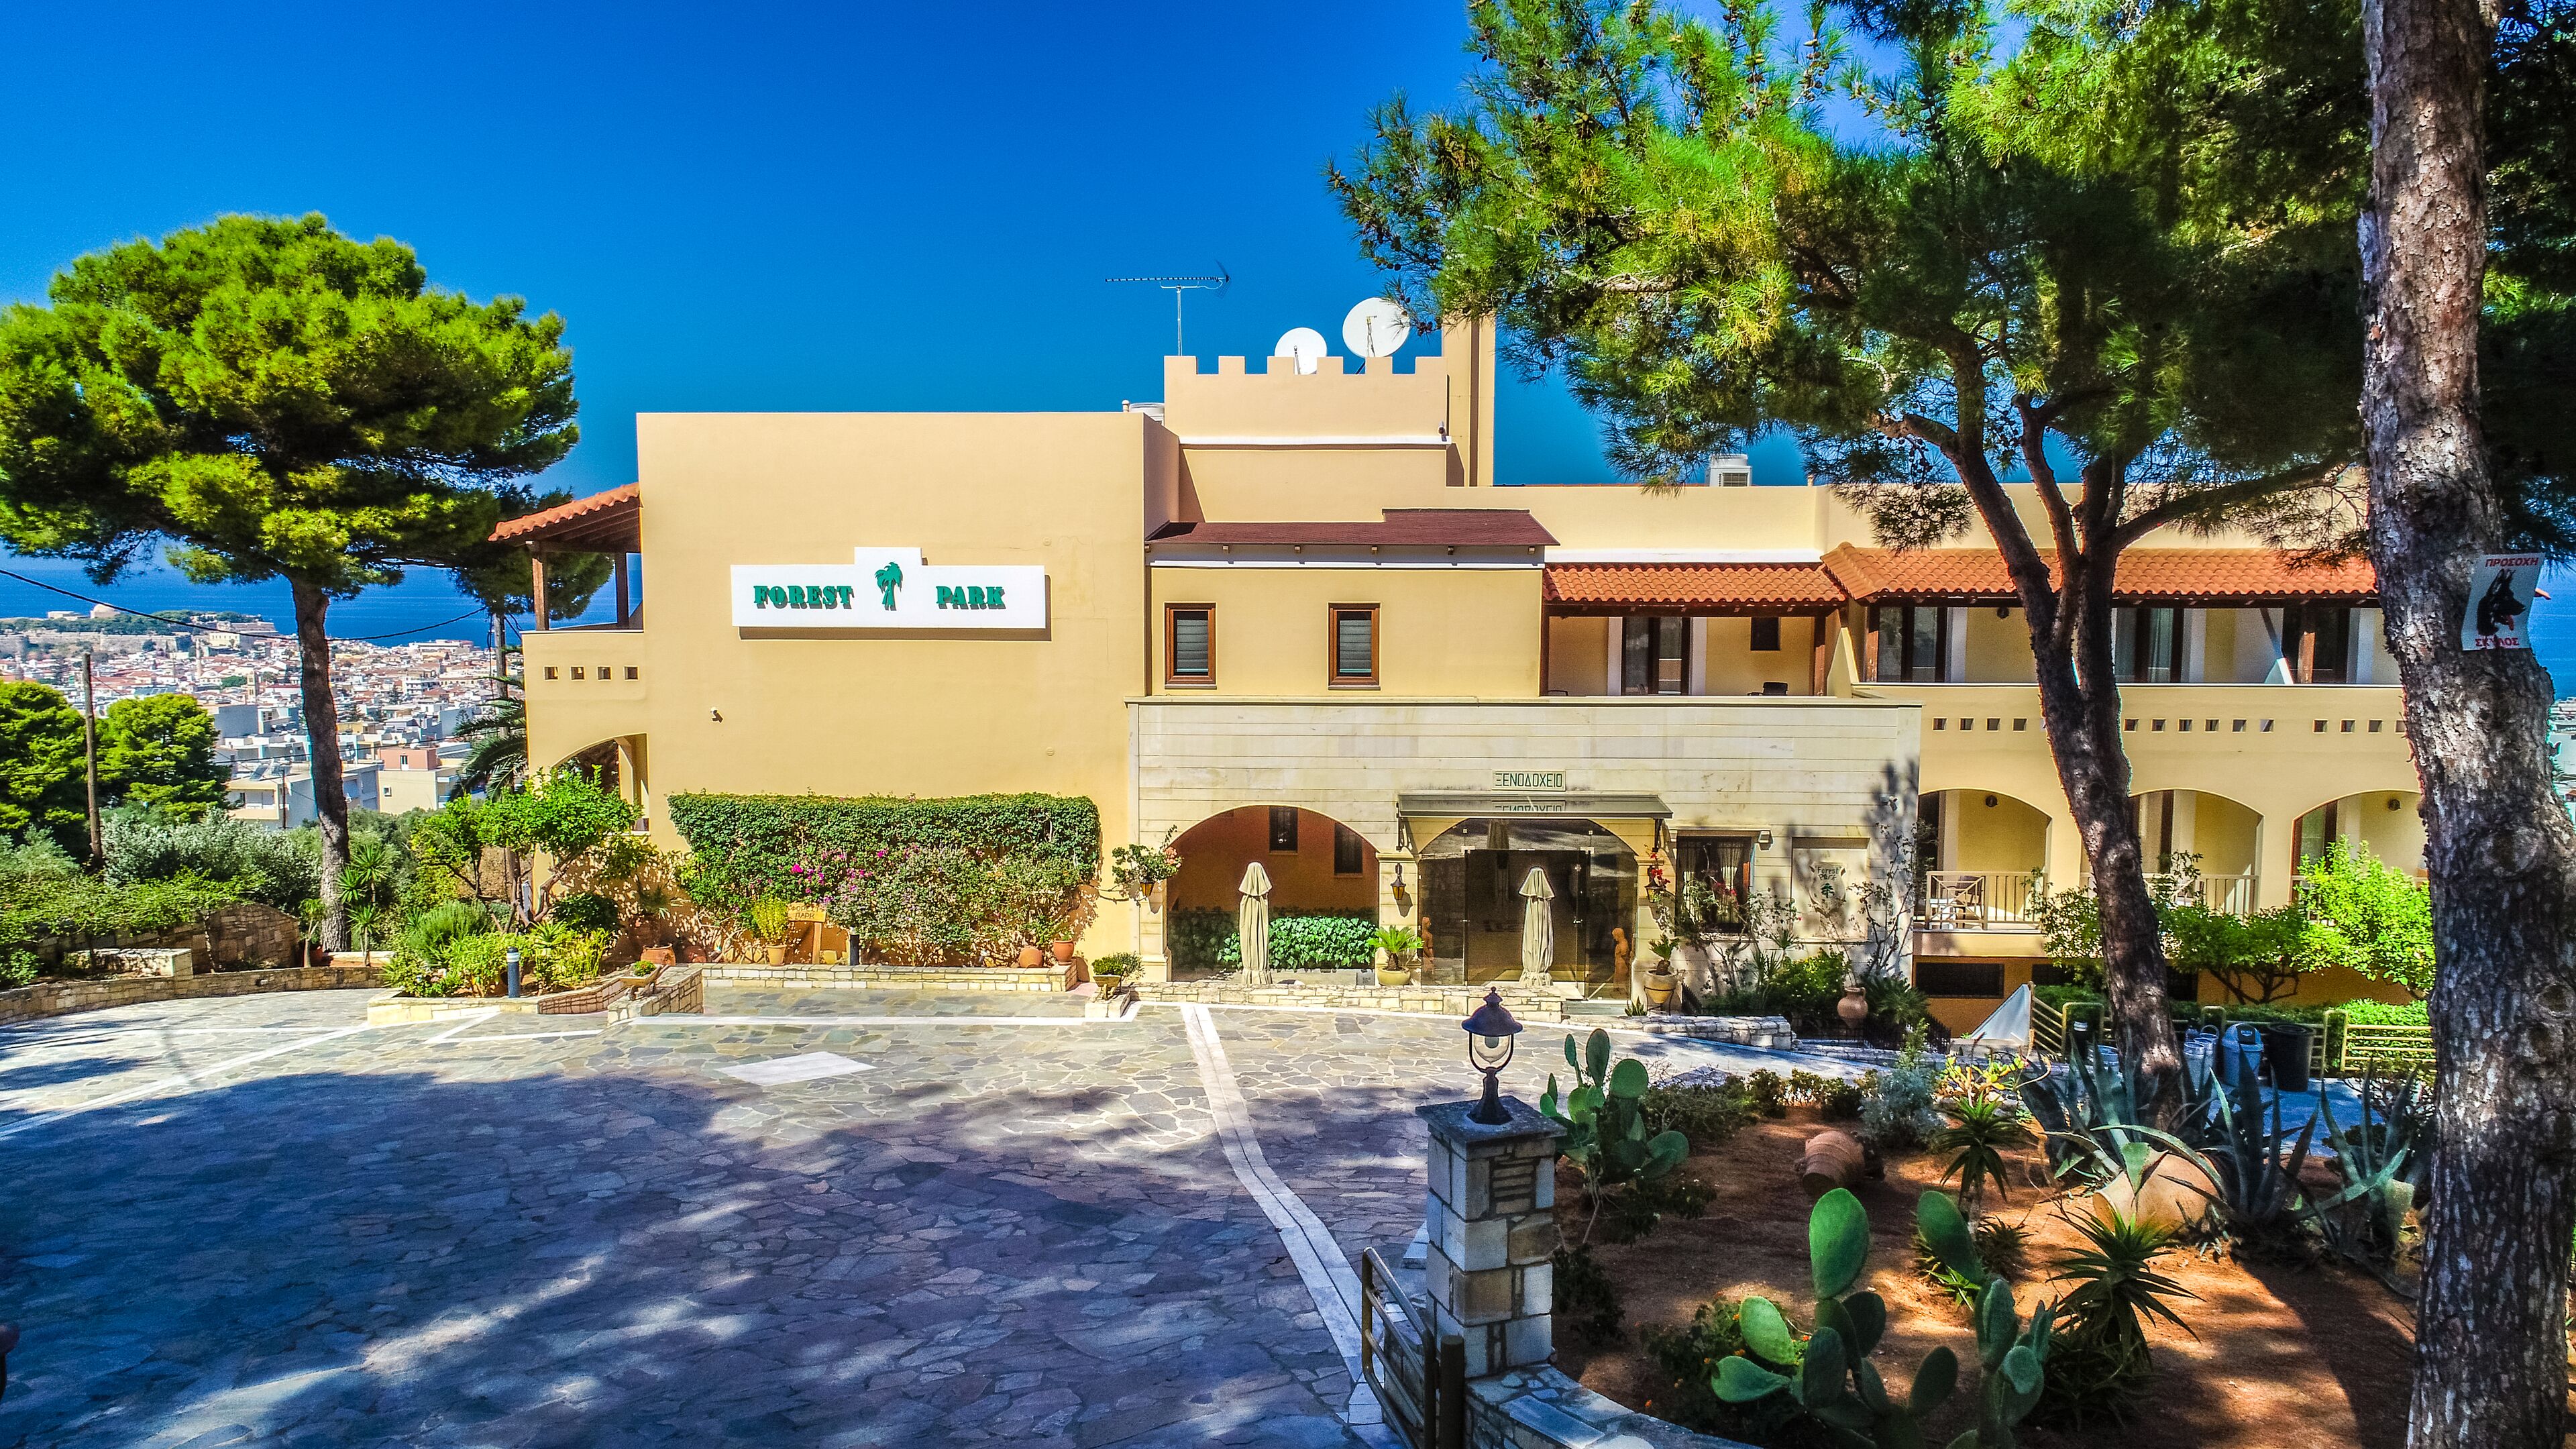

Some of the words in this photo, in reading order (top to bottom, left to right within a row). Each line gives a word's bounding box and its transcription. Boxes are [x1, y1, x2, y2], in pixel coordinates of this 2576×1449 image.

[2485, 557, 2539, 568] ΠΡΟΣΟΧΗ
[753, 586, 853, 606] FOREST
[936, 586, 1006, 606] PARK
[1495, 773, 1563, 788] ΞΕΝΟΔΟΧΕΙΟ
